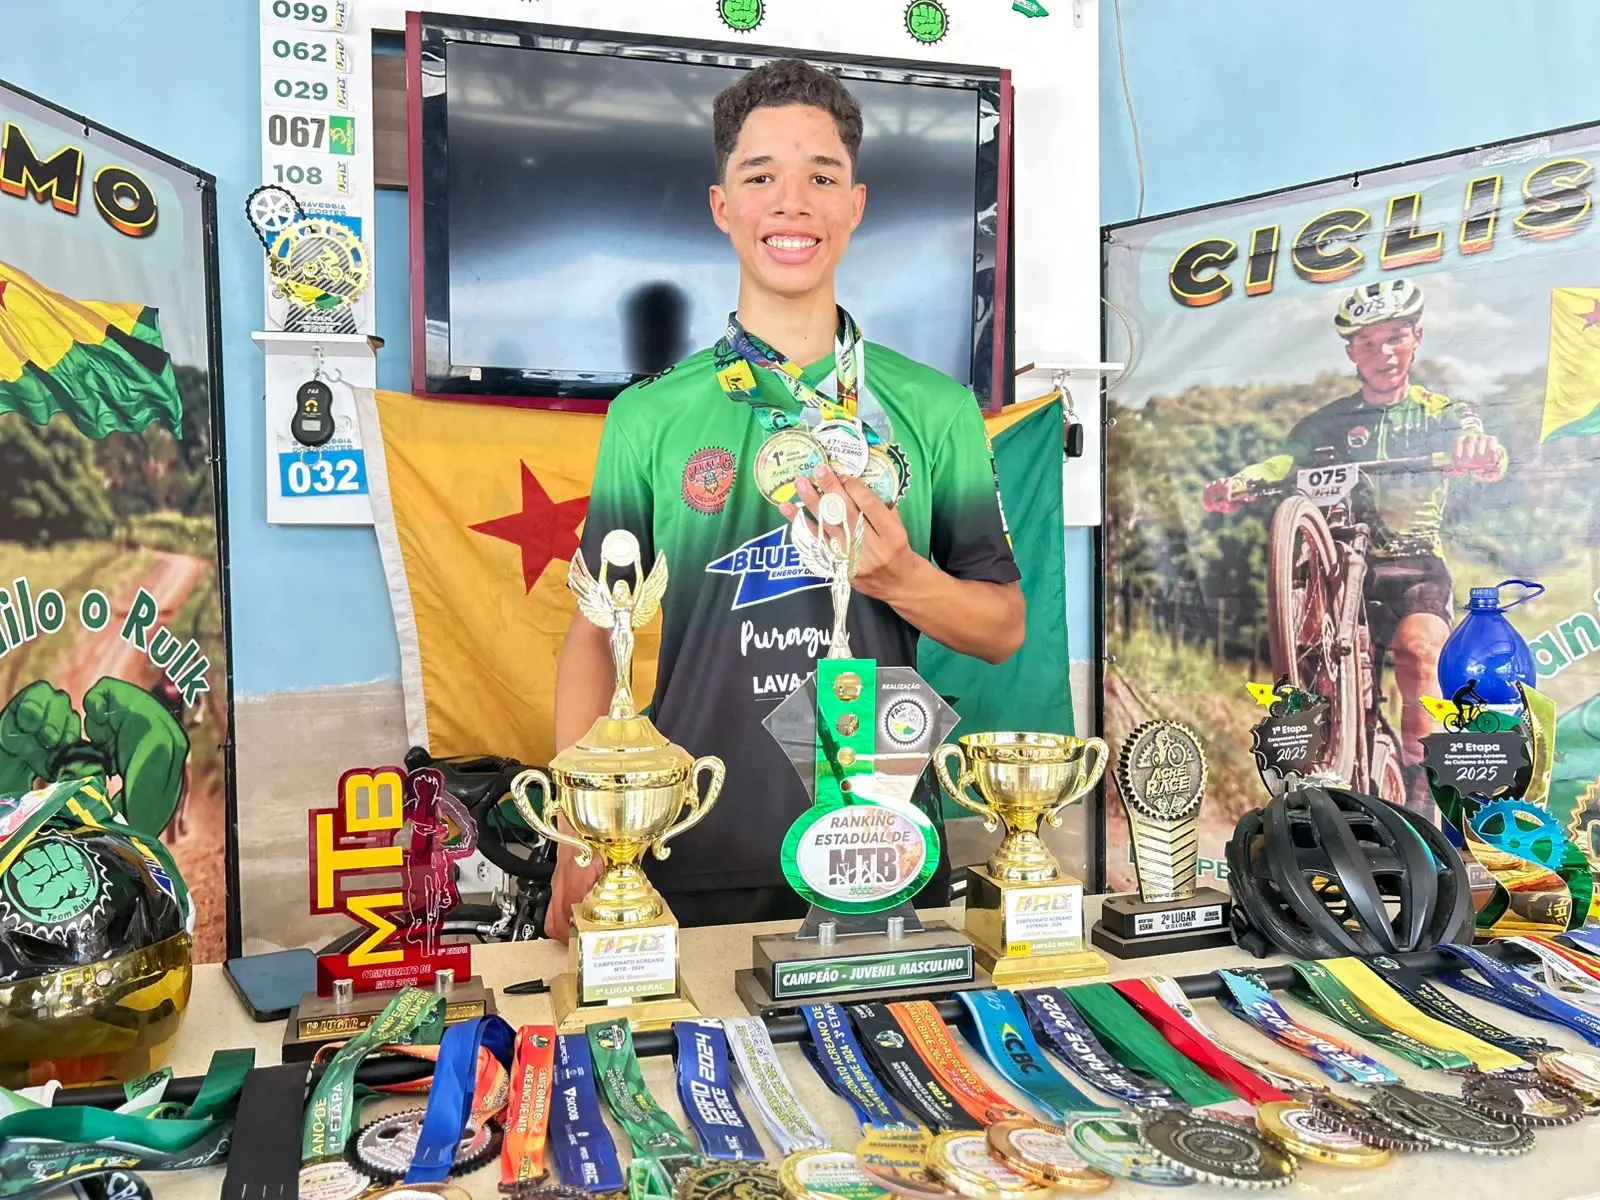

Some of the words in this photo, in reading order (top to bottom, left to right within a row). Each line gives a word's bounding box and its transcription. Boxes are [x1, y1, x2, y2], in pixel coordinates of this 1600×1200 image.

[272, 0, 328, 23] 099
[272, 40, 327, 62] 062
[274, 79, 328, 101] 029
[268, 114, 326, 148] 067
[273, 164, 323, 185] 108
[1168, 157, 1594, 307] CICLIS
[1354, 297, 1386, 317] 075
[288, 459, 359, 493] 032
[799, 462, 815, 470] CBC
[1309, 467, 1347, 486] 075
[771, 568, 803, 578] ENERGY
[80, 589, 110, 632] o
[120, 586, 210, 707] Rulk
[890, 704, 906, 719] FAC
[1282, 725, 1307, 734] Etapa
[1277, 746, 1307, 762] 2025
[1465, 742, 1500, 753] Etapa
[1152, 766, 1187, 781] ACRE
[1456, 767, 1498, 781] 2025
[1146, 778, 1190, 798] RACE
[831, 815, 895, 829] RANKING
[815, 832, 887, 846] ESTADUAL
[892, 831, 911, 843] DE
[317, 772, 404, 967] MTB
[828, 846, 899, 885] MTB
[46, 910, 73, 923] Team
[73, 897, 91, 913] Rulk
[1171, 911, 1196, 924] LUGAR
[362, 965, 419, 979] CAMPEONATO
[420, 964, 431, 973] DE
[594, 960, 634, 968] CAMPEONATO
[783, 967, 838, 987] CAMPEÃO
[850, 964, 896, 981] JUVENIL
[899, 957, 964, 976] MASCULINO
[605, 985, 634, 994] LUGAR
[636, 983, 664, 991] GERAL
[809, 1003, 826, 1021] DE
[1036, 989, 1074, 1036] 2023
[1252, 1001, 1296, 1036] 2022
[321, 1016, 358, 1032] LUGAR
[813, 1019, 846, 1068] ACREANO
[916, 1023, 936, 1047] BIKE
[695, 1032, 715, 1082] 2024
[840, 1044, 857, 1065] 2024
[1000, 1032, 1046, 1083] CBC
[1063, 1023, 1110, 1079] RACE
[521, 1064, 536, 1101] ACREANO
[850, 1062, 868, 1085] BIKE
[312, 1096, 328, 1118] DE
[327, 1081, 347, 1133] ETAPA
[519, 1102, 531, 1114] DE
[564, 1095, 580, 1122] SICOOB
[516, 1115, 528, 1134] MTB
